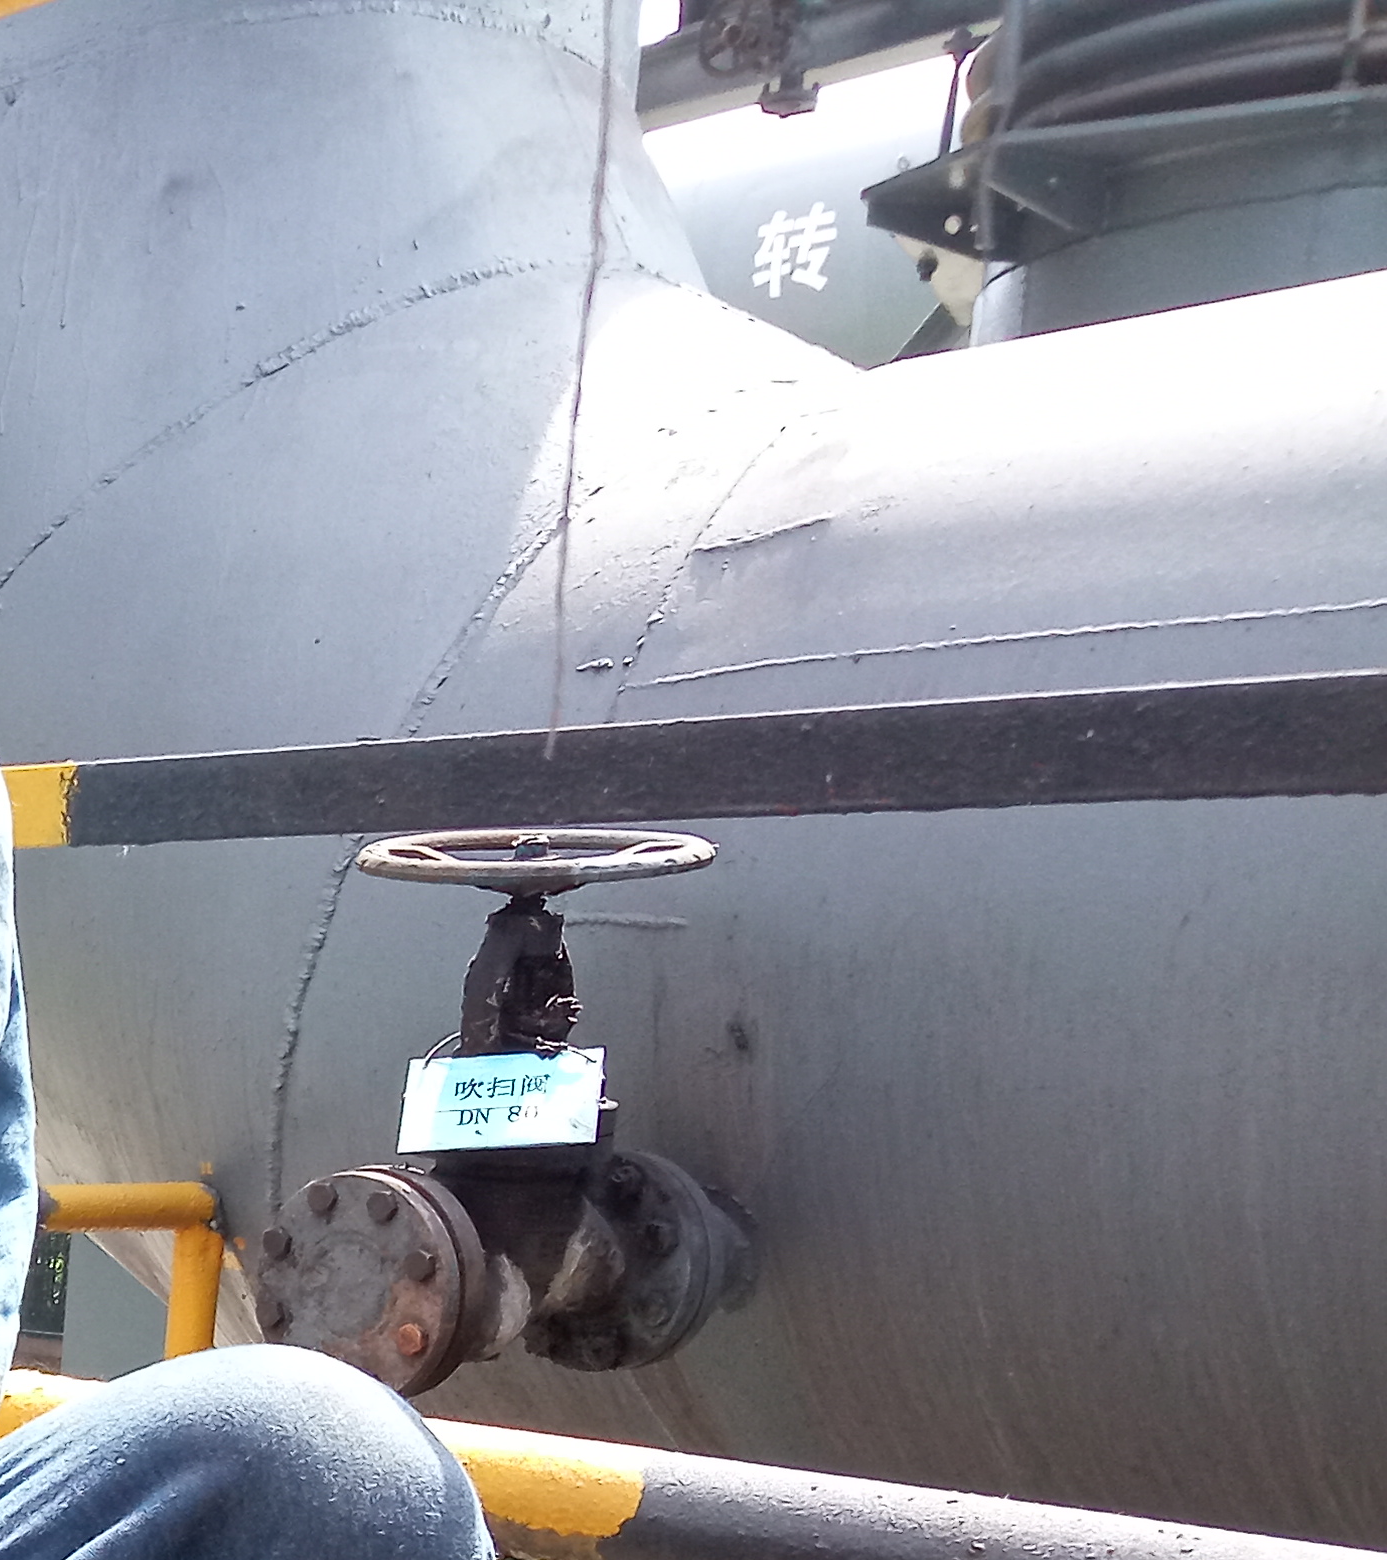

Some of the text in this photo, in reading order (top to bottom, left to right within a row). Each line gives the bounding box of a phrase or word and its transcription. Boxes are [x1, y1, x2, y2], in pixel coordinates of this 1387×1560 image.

[752, 201, 838, 299] 转
[453, 1073, 552, 1102] 吹扫阀
[455, 1104, 539, 1126] DN 80
